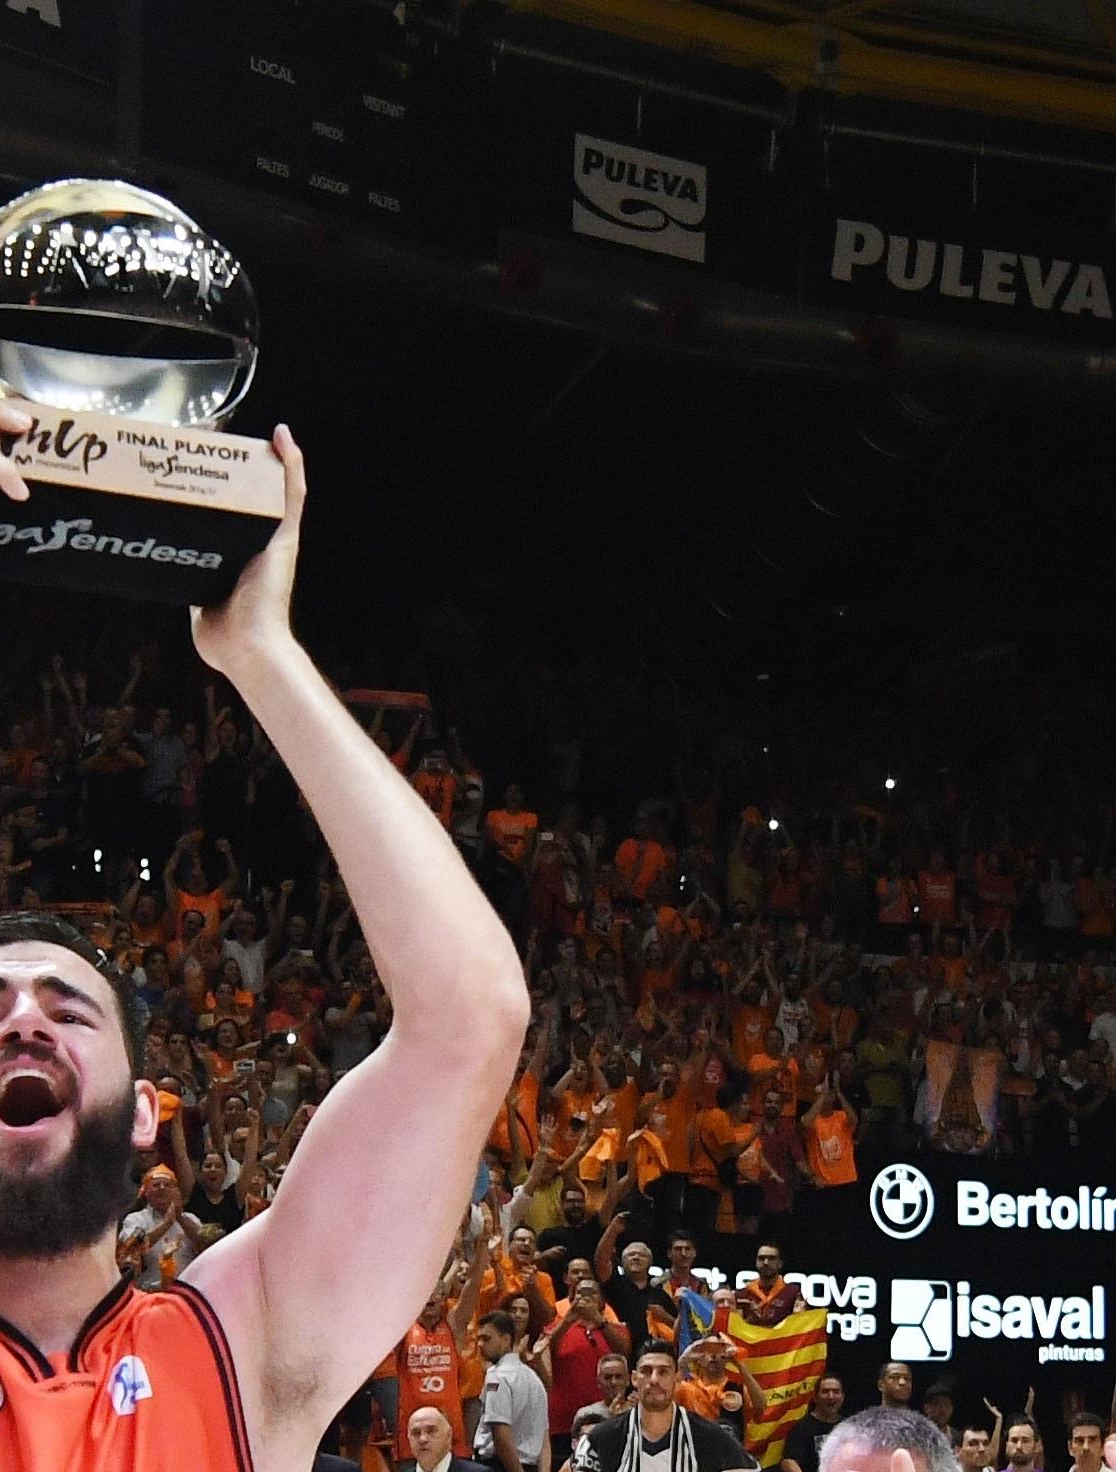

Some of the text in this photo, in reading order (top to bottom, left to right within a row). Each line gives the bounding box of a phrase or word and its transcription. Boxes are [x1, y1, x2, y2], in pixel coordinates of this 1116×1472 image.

[250, 55, 297, 84] LOCAL
[583, 148, 698, 203] PULEVA
[830, 217, 1114, 320] PULEVA
[116, 429, 250, 464] FINAL PLAYOFF
[957, 1280, 1105, 1340] isaval
[1038, 1342, 1106, 1364] pinturas
